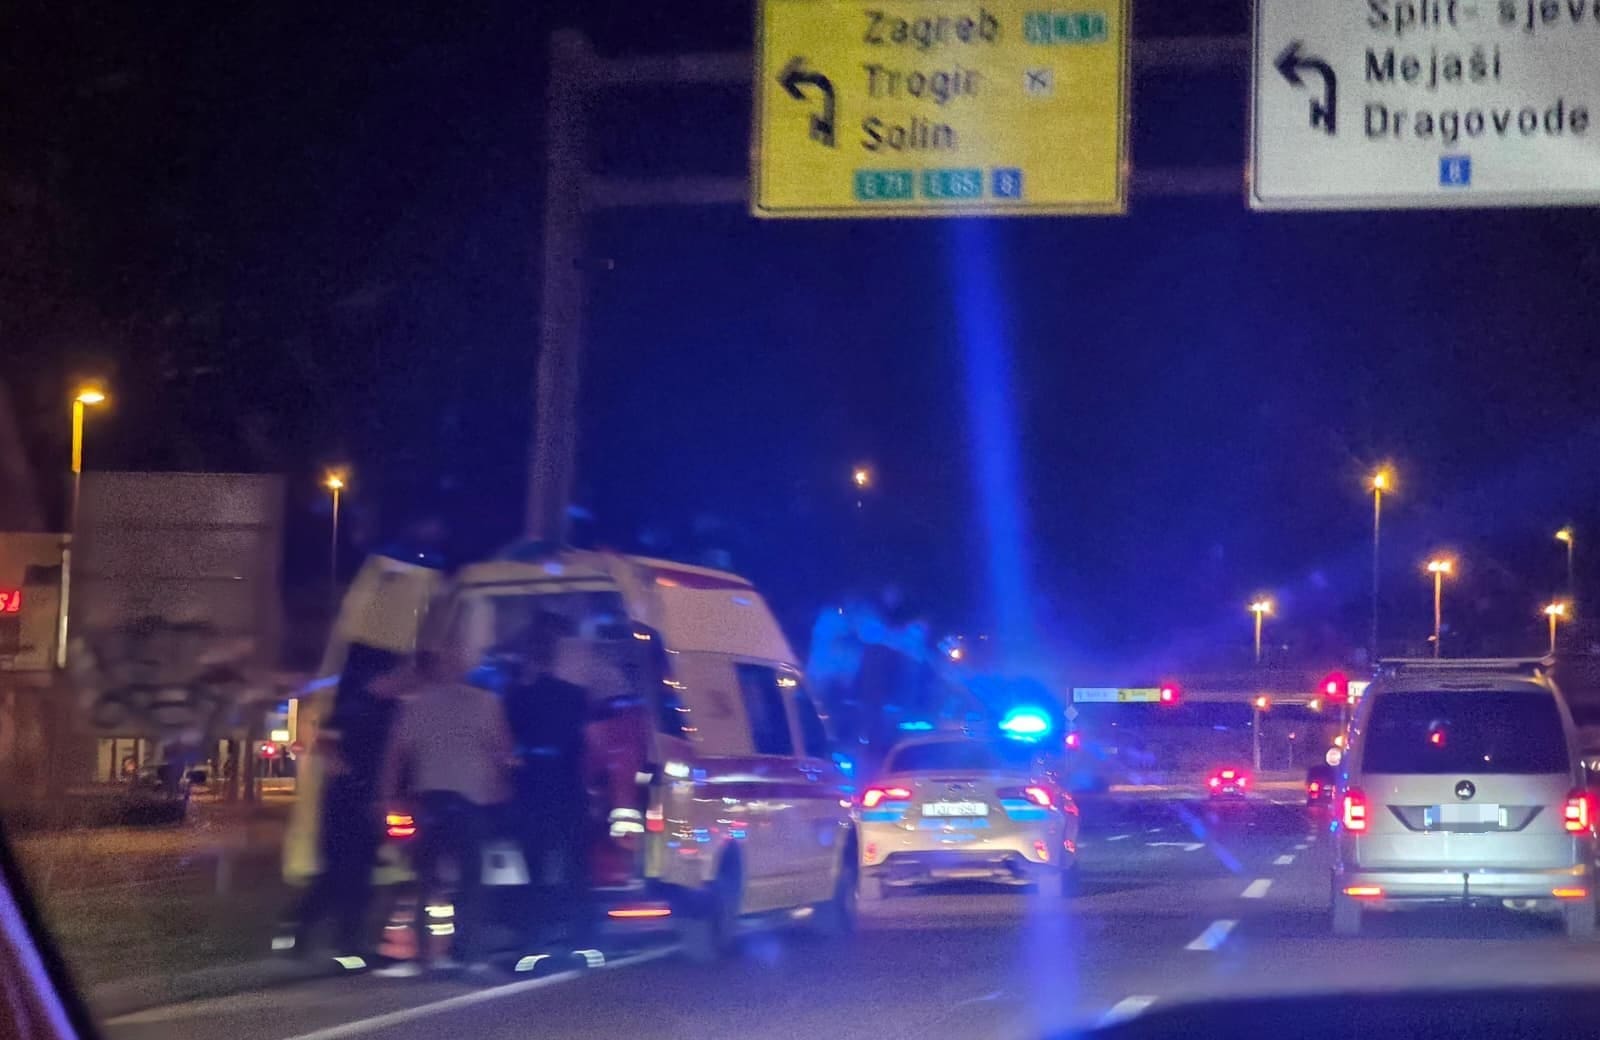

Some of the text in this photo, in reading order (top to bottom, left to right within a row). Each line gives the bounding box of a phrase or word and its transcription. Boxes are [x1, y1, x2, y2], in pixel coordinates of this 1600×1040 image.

[864, 7, 998, 51] Zagreb
[862, 63, 980, 105] Trogir
[1365, 45, 1500, 90] Mejaši
[861, 115, 955, 151] Solin
[1365, 98, 1589, 144] Dragovode
